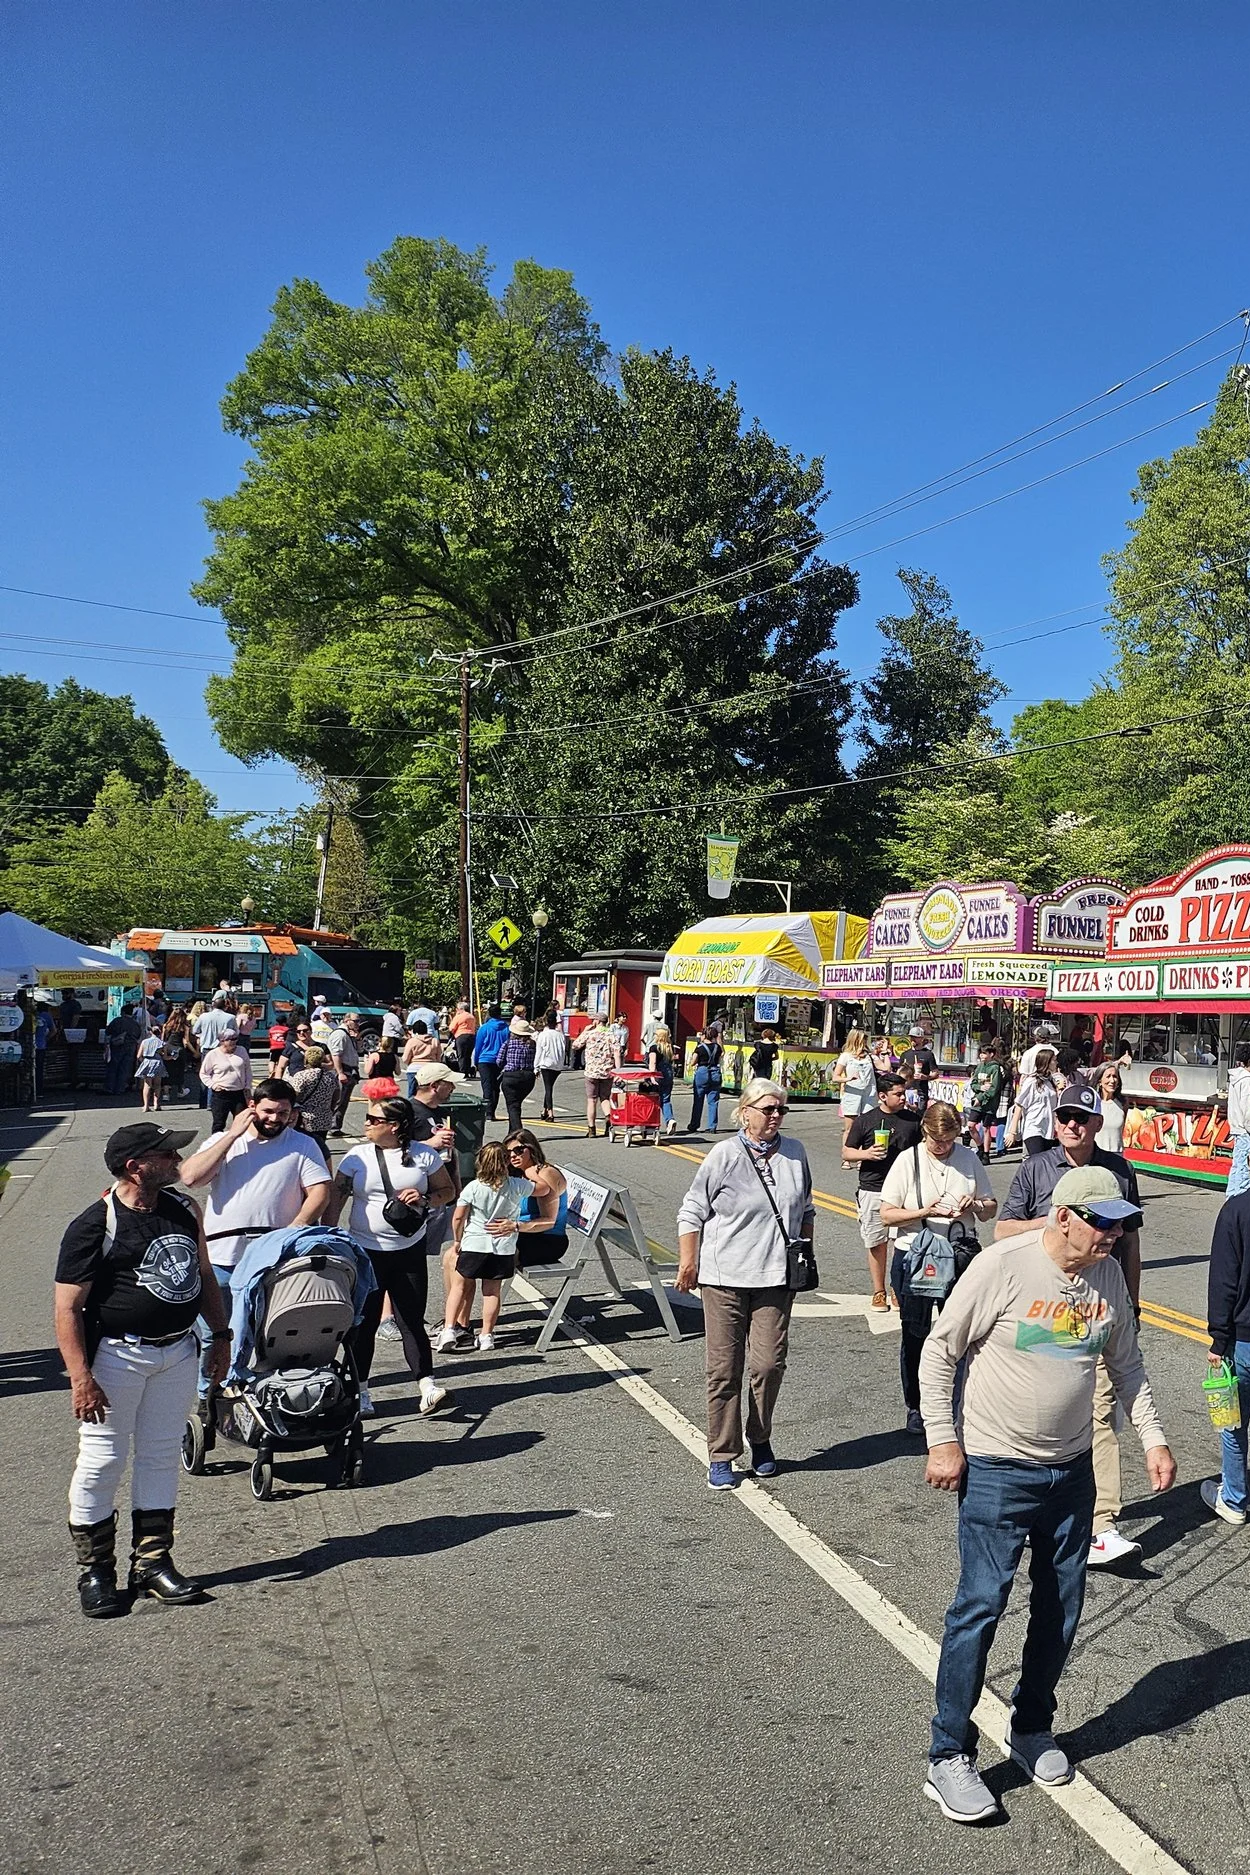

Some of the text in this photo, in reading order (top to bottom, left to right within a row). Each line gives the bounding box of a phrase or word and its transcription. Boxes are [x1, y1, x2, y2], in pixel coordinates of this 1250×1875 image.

[1195, 877, 1219, 892] HAND
[923, 894, 959, 919] LEMONADE
[969, 897, 1001, 913] FUNNEL
[1076, 893, 1124, 910] FRESH
[884, 908, 911, 920] FUNNEL
[929, 912, 950, 923] FRESH
[1135, 906, 1165, 923] COLD
[875, 924, 911, 946] CAKES
[967, 914, 1009, 940] CAKES
[1045, 913, 1104, 941] FUNNEL
[1129, 924, 1169, 942] DRINKS
[190, 937, 233, 948] TOM'S
[673, 958, 745, 985] CORN ROAST
[893, 963, 963, 982] ELEPHANT EARS
[999, 961, 1048, 970] Squeezed
[53, 971, 130, 981] GeorgiaFireSteel.com
[826, 966, 886, 983] ELEPHANT EARS
[971, 970, 1048, 983] LEMONADE
[1058, 970, 1155, 992] PIZZA COLD
[1169, 966, 1219, 990] DRINKS
[990, 988, 1028, 997] OREOS
[757, 1001, 778, 1011] ICED
[759, 1010, 775, 1021] TEA
[1026, 1300, 1106, 1321] BIG SUR
